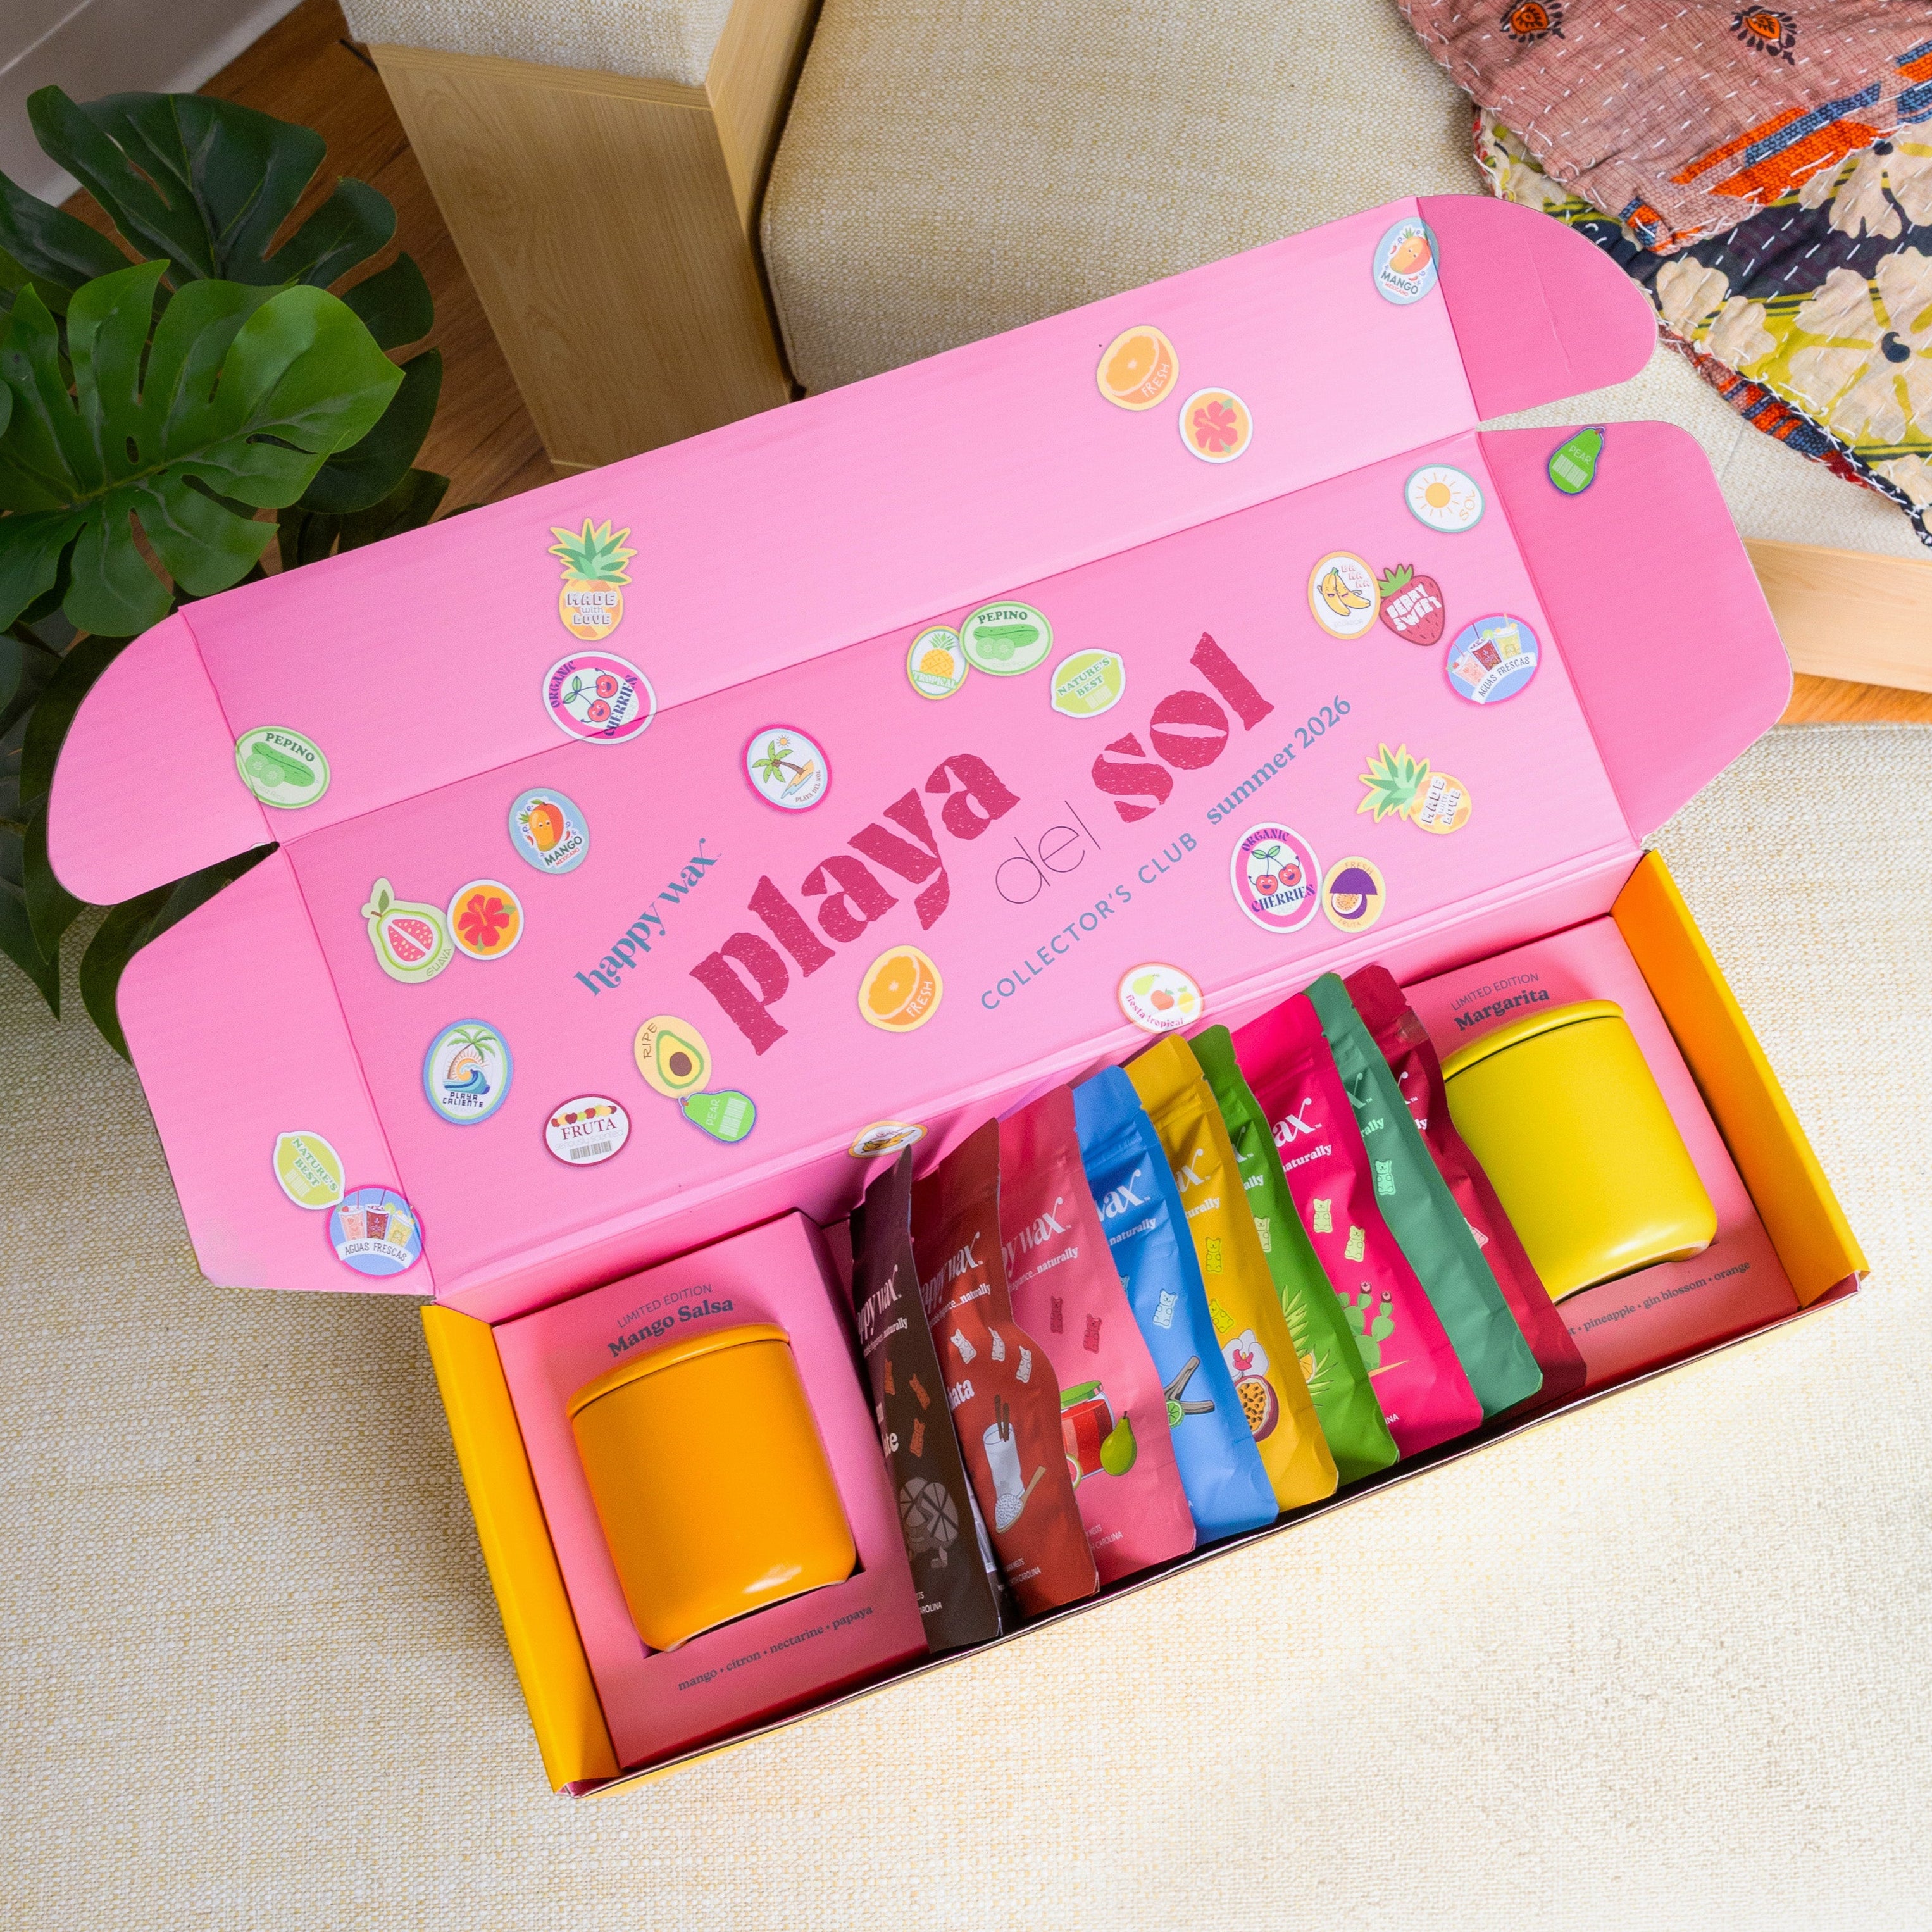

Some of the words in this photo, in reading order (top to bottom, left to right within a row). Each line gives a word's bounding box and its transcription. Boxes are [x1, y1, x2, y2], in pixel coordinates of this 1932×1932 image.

[1380, 270, 1418, 294] MANGO
[1385, 282, 1409, 297] MEXICANO
[1141, 363, 1169, 397] FRESH
[1568, 445, 1592, 465] PEAR
[1458, 490, 1476, 521] SOL
[566, 591, 617, 606] MADE
[581, 606, 604, 614] with
[1386, 583, 1430, 618] BERRY
[1392, 595, 1442, 632] SWEET
[573, 614, 612, 625] LOVE
[977, 611, 1028, 625] PEPINO
[549, 660, 576, 709] ORGANIC
[913, 671, 957, 689] TROPICAL
[1057, 657, 1111, 696] NATURE'S
[1076, 675, 1104, 698] BEST
[1477, 674, 1498, 697] AGUAS
[1497, 656, 1531, 676] FRESCAS
[603, 674, 638, 737] CHERRIES
[265, 732, 315, 762] PEPINO
[795, 792, 814, 803] PLAYA
[544, 835, 582, 866] MANGO
[689, 753, 1021, 1056] playa
[995, 800, 1101, 904] del
[1091, 632, 1274, 823] sol
[980, 885, 1132, 1010] COLLECTOR'S
[1138, 832, 1198, 884] CLUB
[1206, 743, 1296, 825] summer
[1294, 695, 1351, 749] 2026
[1241, 828, 1290, 852] ORGANIC
[555, 847, 580, 866] MEXICANO
[1344, 861, 1374, 876] FRESH
[1251, 883, 1316, 913] CHERRIES
[1338, 918, 1361, 928] FRUTA
[426, 948, 452, 977] GUAVA
[573, 901, 666, 996] happy
[906, 980, 933, 1018] FRESH
[1450, 985, 1492, 1011] LIMITED
[1493, 973, 1540, 992] EDITION
[1126, 994, 1145, 1019] fiesta
[1147, 1015, 1184, 1028] tropical
[1454, 989, 1550, 1031] Margarita
[642, 1022, 658, 1059] RIPE
[442, 1097, 483, 1108] CALIENTE
[450, 1092, 478, 1101] PLAYA
[706, 1099, 720, 1126] PEAR
[561, 1118, 617, 1140] FRUTA
[292, 1138, 339, 1192] NATURE'S
[295, 1157, 320, 1187] BEST
[1109, 1218, 1157, 1246] naturally
[344, 1242, 370, 1256] AGUAS
[373, 1242, 408, 1262] FRESCAS
[616, 1300, 662, 1328] LIMITED
[663, 1283, 713, 1306] EDITION
[1583, 1304, 1636, 1333] pineapple
[1642, 1296, 1661, 1310] gin
[1660, 1277, 1707, 1300] blossom
[1714, 1261, 1752, 1281] orange
[607, 1316, 675, 1358] Mango
[677, 1299, 734, 1323] Salsa
[1095, 1531, 1124, 1550] CAROLINA
[677, 1668, 718, 1692] mango
[726, 1650, 761, 1672] citron
[770, 1625, 824, 1655] nectarine
[832, 1606, 873, 1630] papaya
